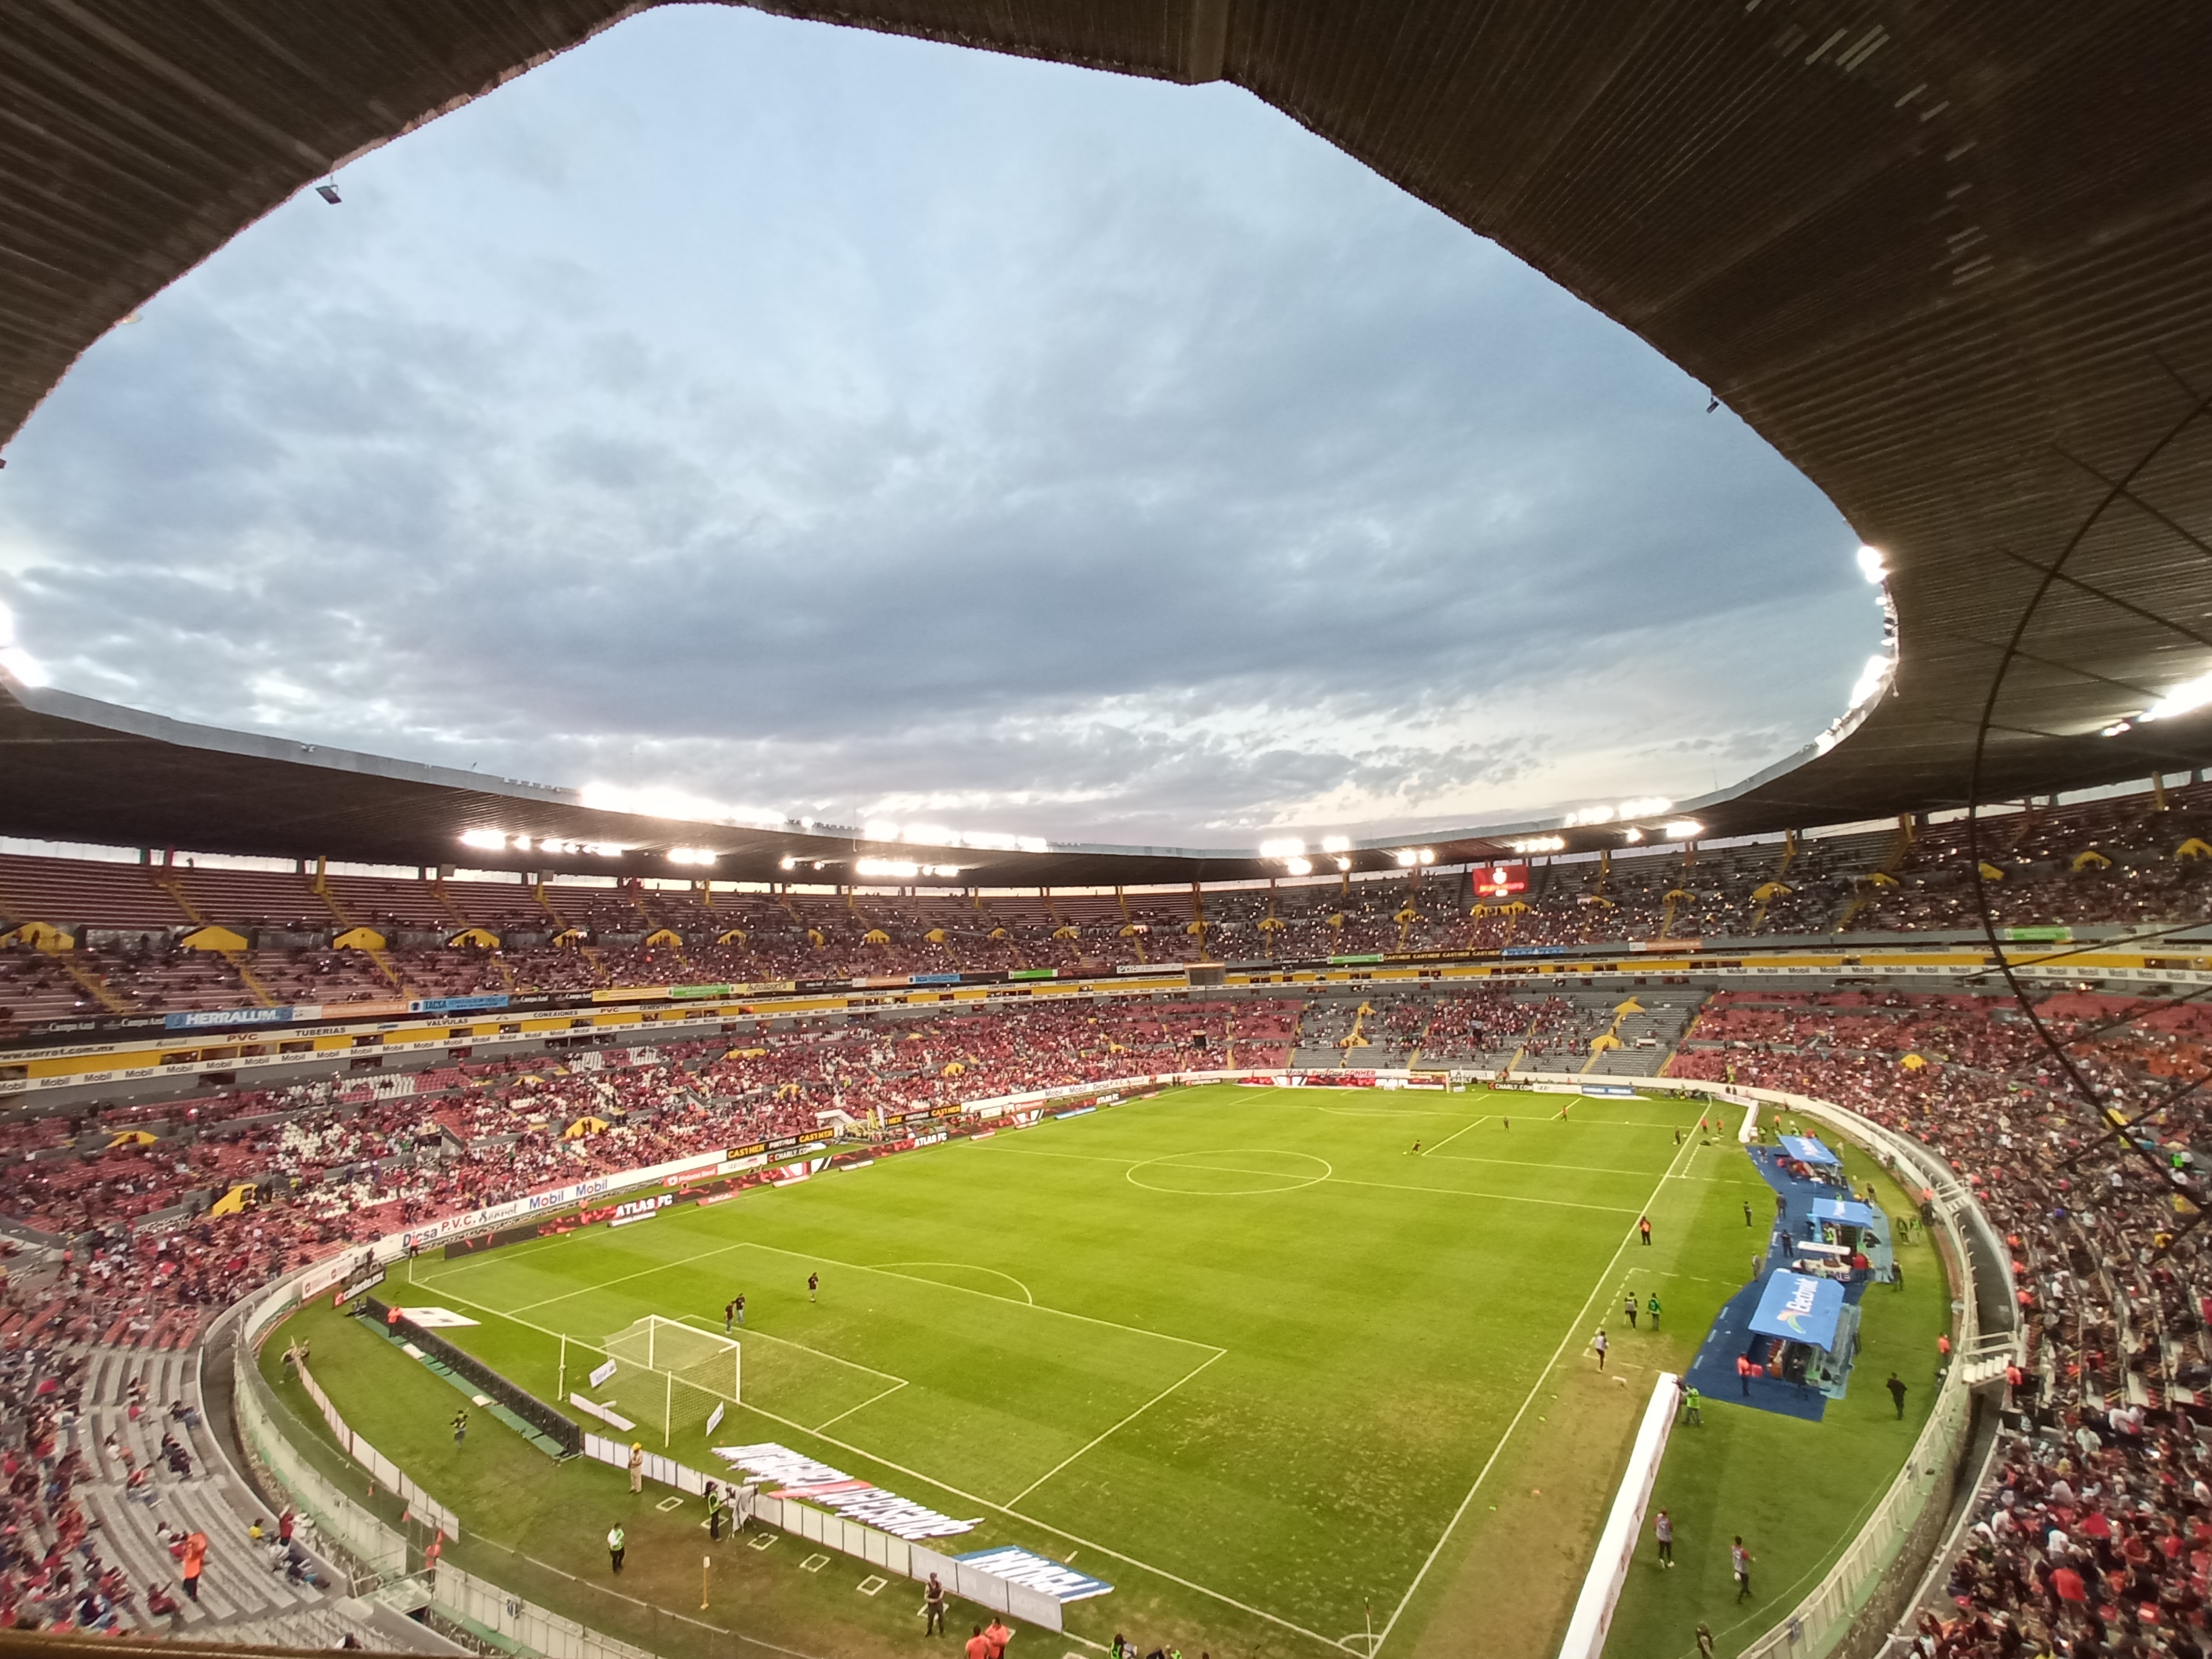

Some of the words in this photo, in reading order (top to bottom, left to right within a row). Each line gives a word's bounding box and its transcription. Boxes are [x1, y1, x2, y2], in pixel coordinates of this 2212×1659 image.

[185, 1010, 276, 1025] HERRALUM
[426, 1018, 469, 1027] VALVULAS
[295, 1027, 346, 1038] TUBERIAS
[227, 1033, 259, 1042] PVC
[316, 1050, 340, 1059] Mobil
[350, 1047, 373, 1055] Mobil
[244, 1057, 270, 1065] Mobil
[281, 1054, 306, 1062] Mobil
[167, 1064, 194, 1073] Mobil
[206, 1060, 233, 1069] Mobil
[84, 1072, 112, 1082] Mobil
[125, 1068, 154, 1078] Mobil
[40, 1077, 70, 1087] Mobil
[915, 1133, 937, 1147] ATLAS
[937, 1132, 947, 1142] FC
[529, 1191, 565, 1210] Mobil
[575, 1179, 608, 1197] Mobil
[615, 1197, 655, 1217] ATLAS
[657, 1194, 673, 1208] FC
